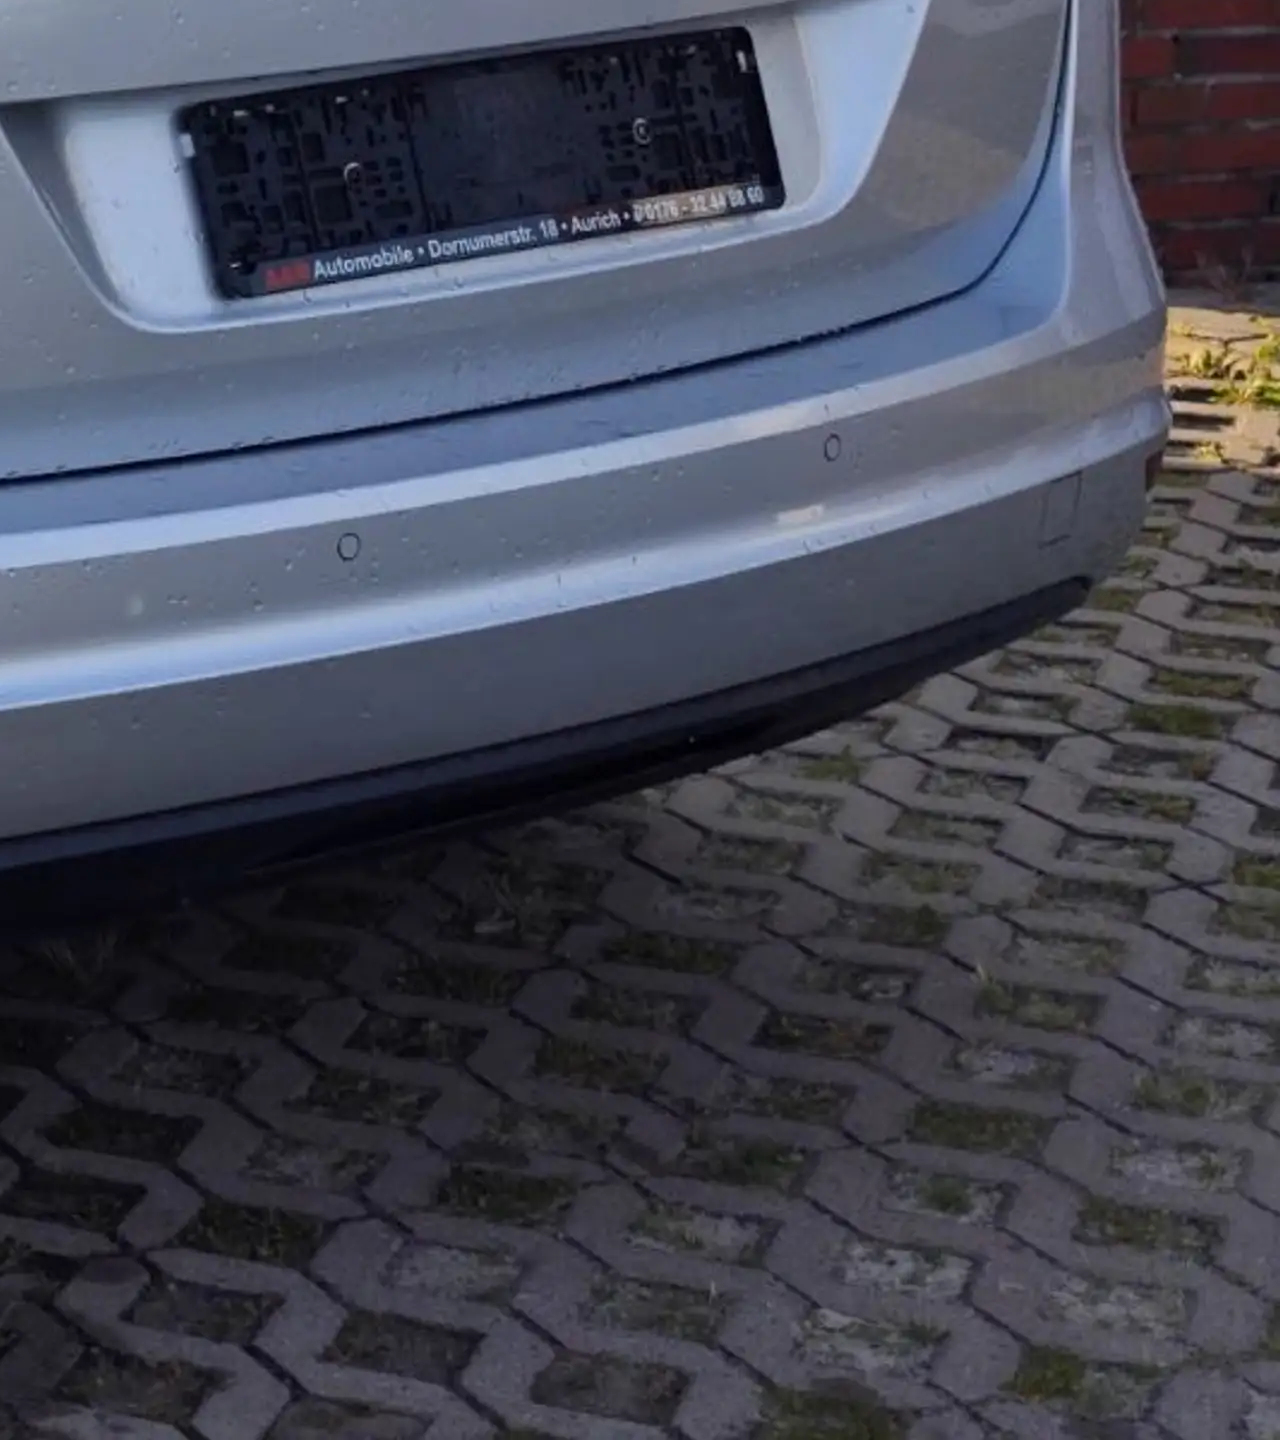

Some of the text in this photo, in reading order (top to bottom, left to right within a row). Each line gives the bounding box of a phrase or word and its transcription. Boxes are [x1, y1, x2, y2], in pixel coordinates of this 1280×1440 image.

[313, 244, 416, 280] Automobile
[427, 225, 537, 259] Dornumerstr.
[541, 218, 560, 240] 18
[571, 208, 622, 235] Aurich
